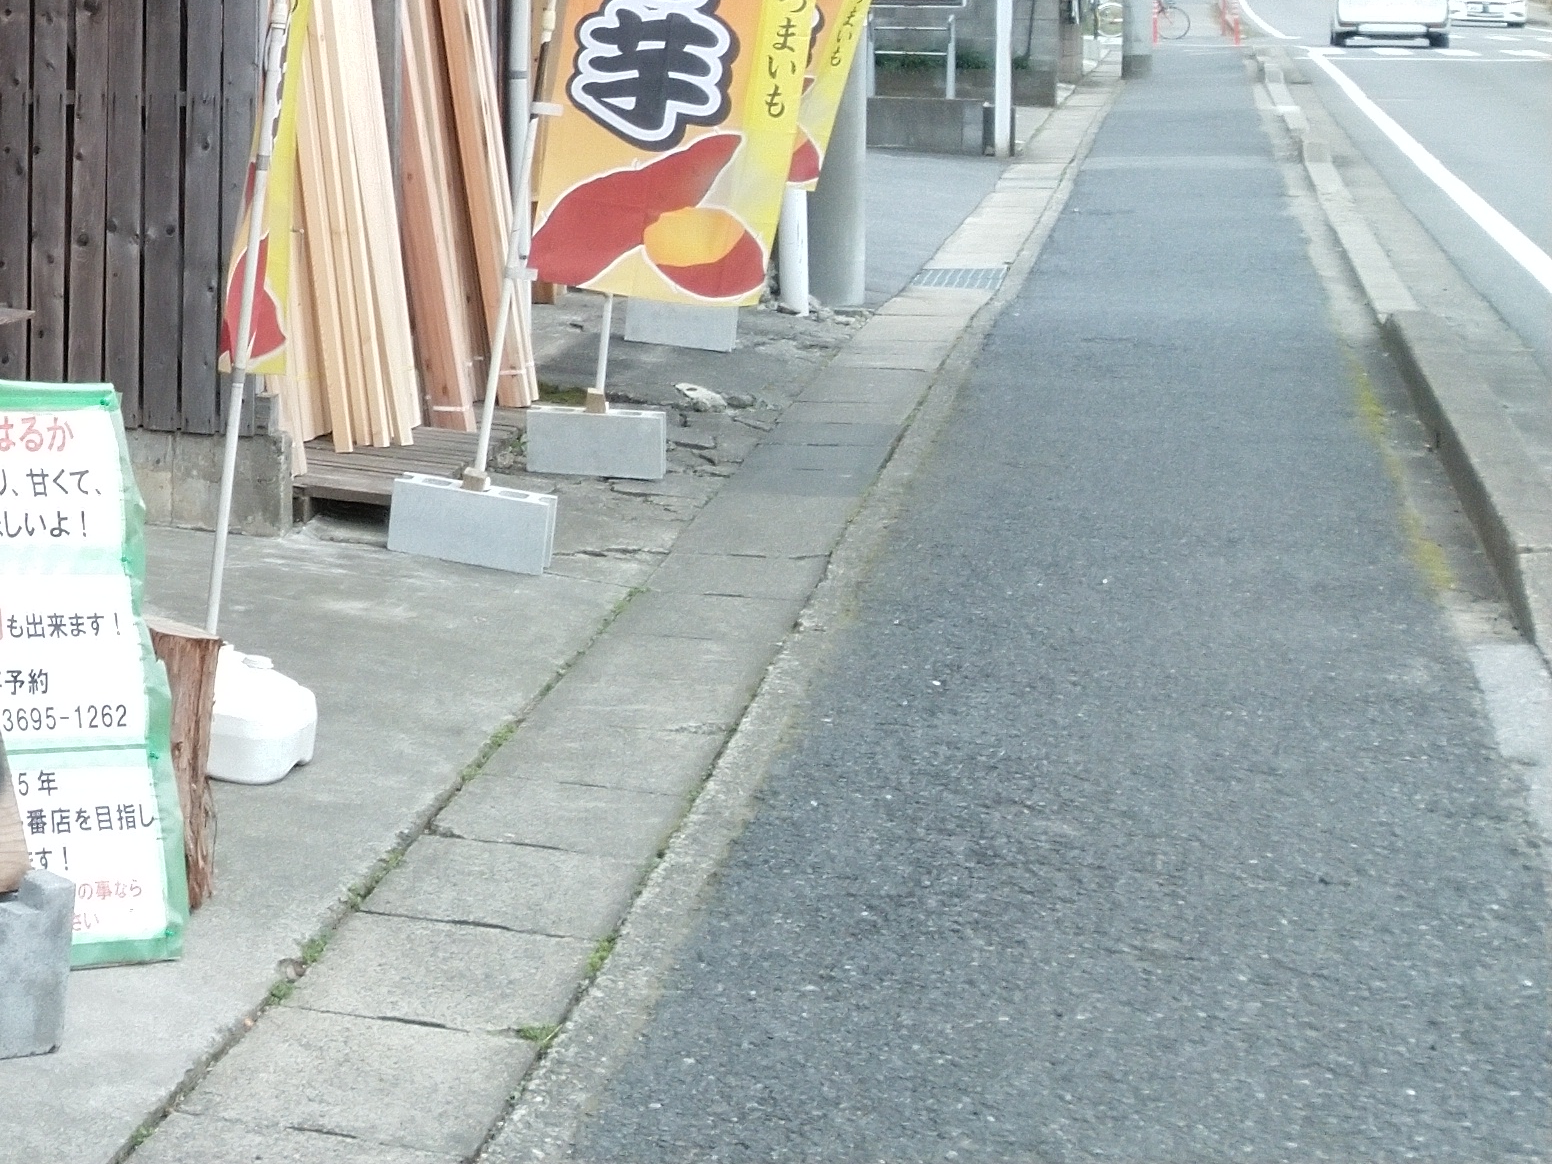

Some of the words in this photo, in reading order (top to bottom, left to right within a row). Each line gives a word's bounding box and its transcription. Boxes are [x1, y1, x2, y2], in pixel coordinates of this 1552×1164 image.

[2, 704, 127, 732] 3695-1262
[21, 803, 155, 835] 番店を目指し
